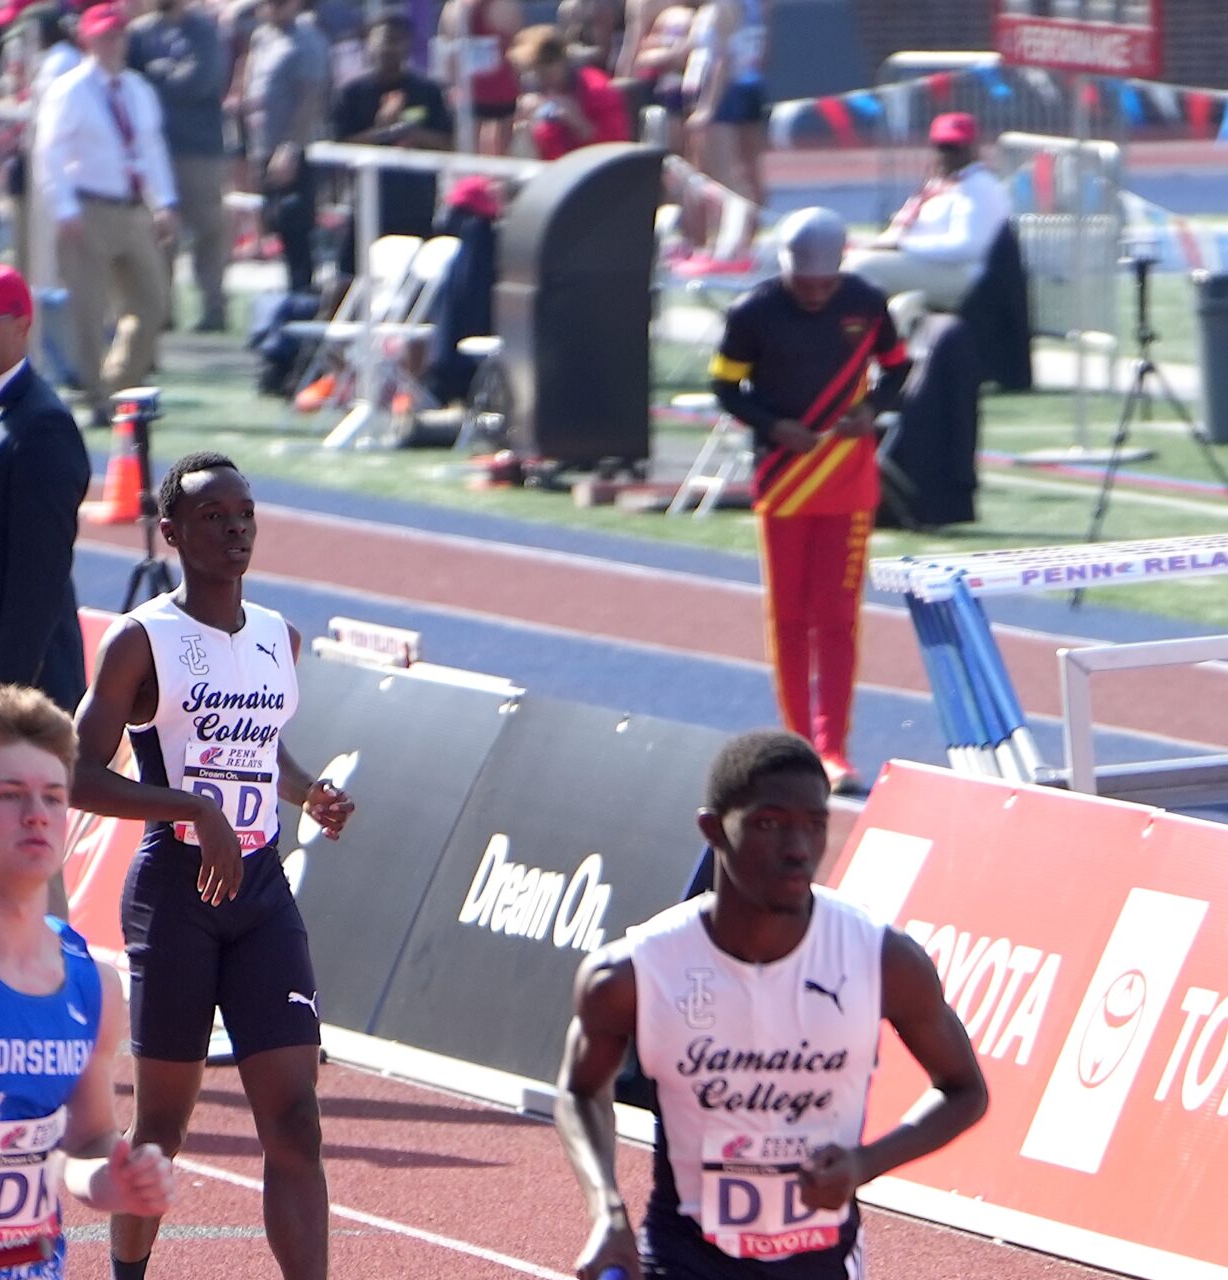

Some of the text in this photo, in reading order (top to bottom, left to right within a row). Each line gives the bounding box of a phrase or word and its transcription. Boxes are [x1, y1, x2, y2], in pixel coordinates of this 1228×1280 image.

[1021, 562, 1113, 585] PENN
[182, 682, 284, 713] Jamaica
[192, 713, 279, 748] College
[228, 748, 258, 760] PENN
[198, 768, 225, 780] Dream
[458, 832, 566, 940] Dream
[677, 1036, 848, 1075] Jamaica
[693, 1076, 835, 1125] College
[746, 1228, 825, 1253] TOYOTA
